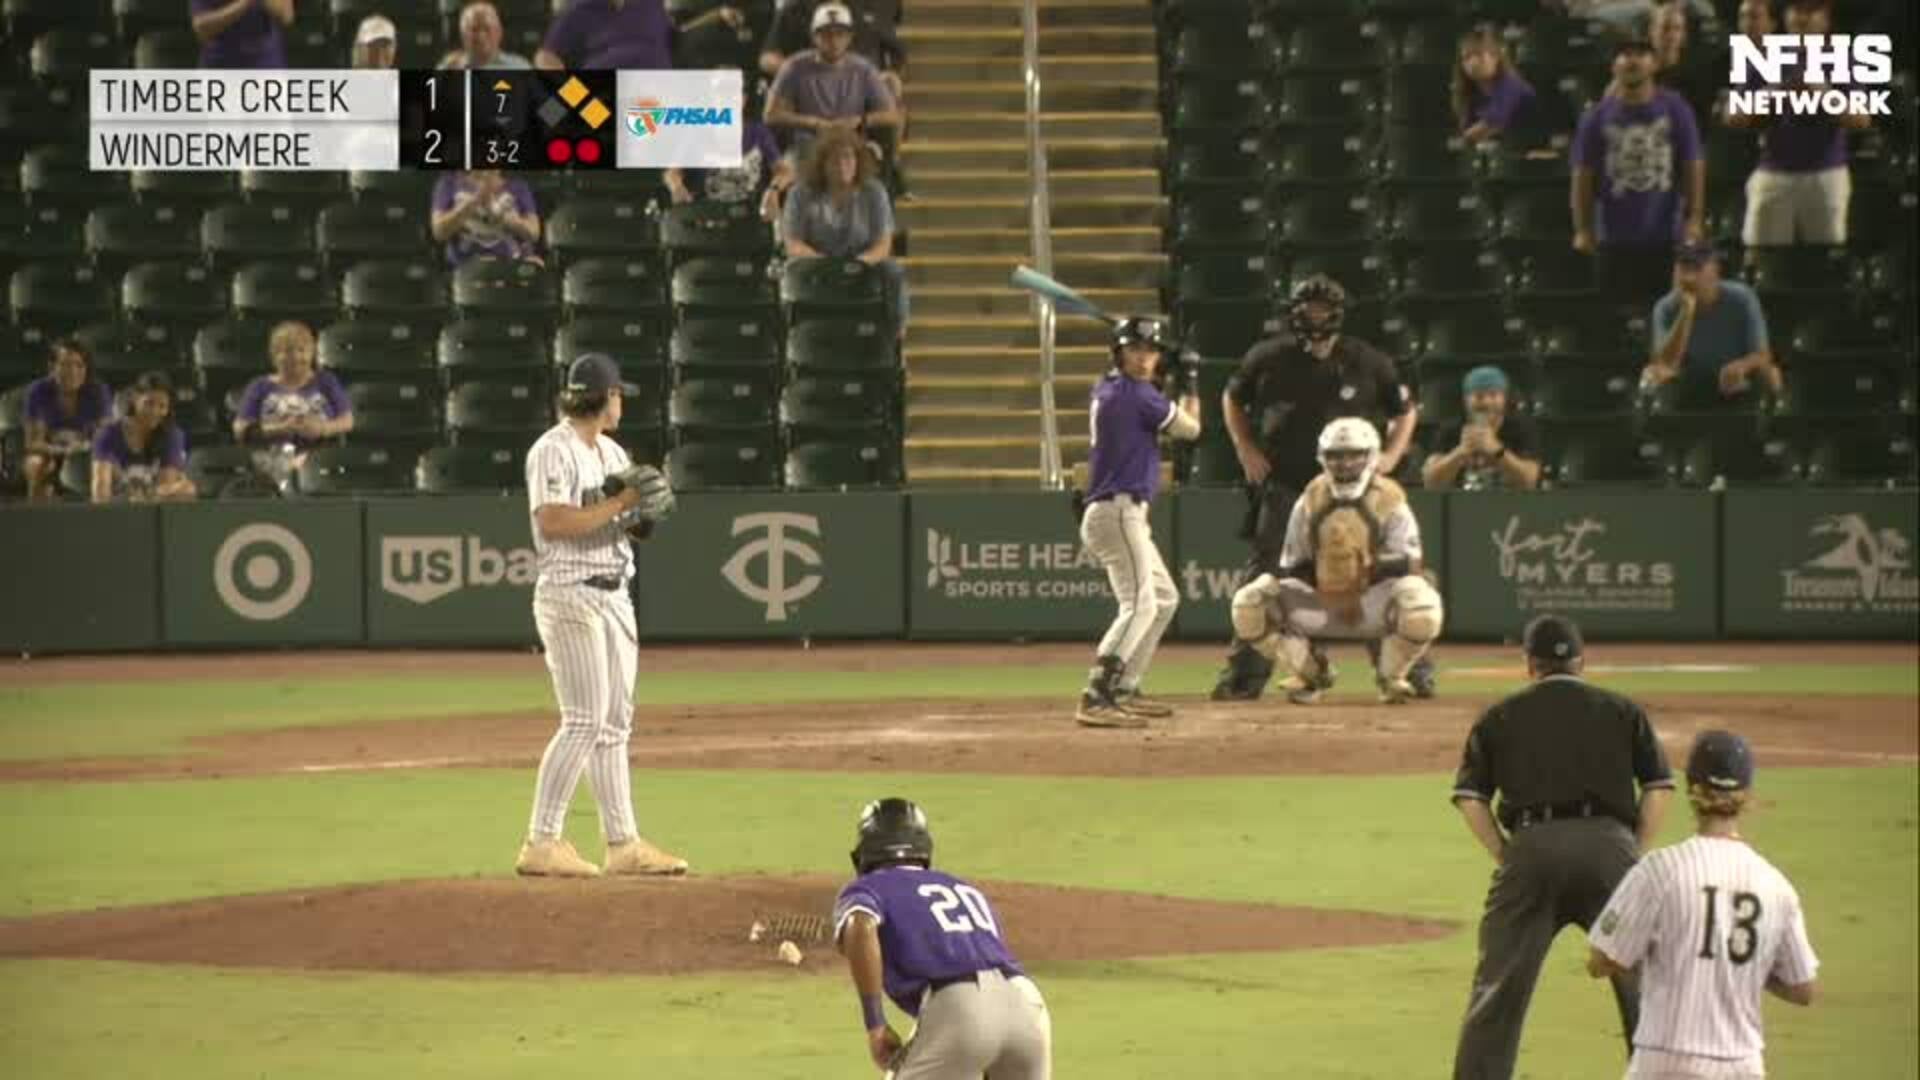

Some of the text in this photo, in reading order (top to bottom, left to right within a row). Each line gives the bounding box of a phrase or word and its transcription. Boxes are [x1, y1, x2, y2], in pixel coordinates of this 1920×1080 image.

[960, 543, 1106, 569] LEE HEA
[1517, 562, 1676, 584] MYERS
[945, 580, 1030, 598] SPORTS
[917, 883, 1001, 939] 20
[1698, 885, 1763, 967] 13
